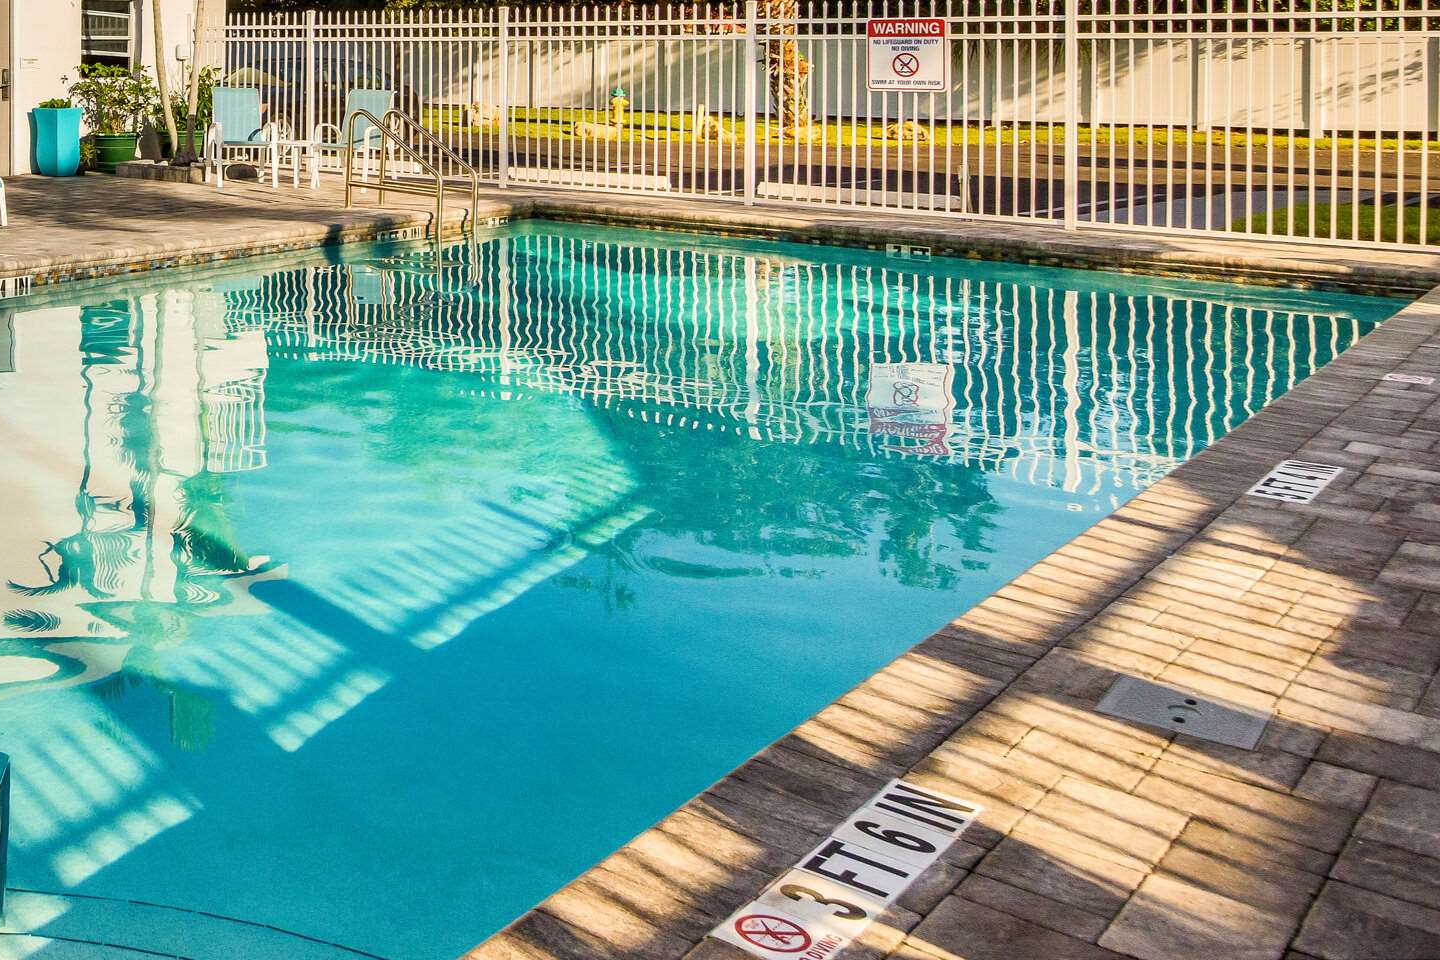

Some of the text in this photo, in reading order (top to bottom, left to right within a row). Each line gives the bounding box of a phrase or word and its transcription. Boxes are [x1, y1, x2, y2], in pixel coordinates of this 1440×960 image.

[872, 22, 940, 34] WARNING
[1253, 460, 1339, 501] 5 FT 4 IN
[779, 783, 976, 921] 3 FT 6 IN
[806, 934, 843, 960] DIVING
